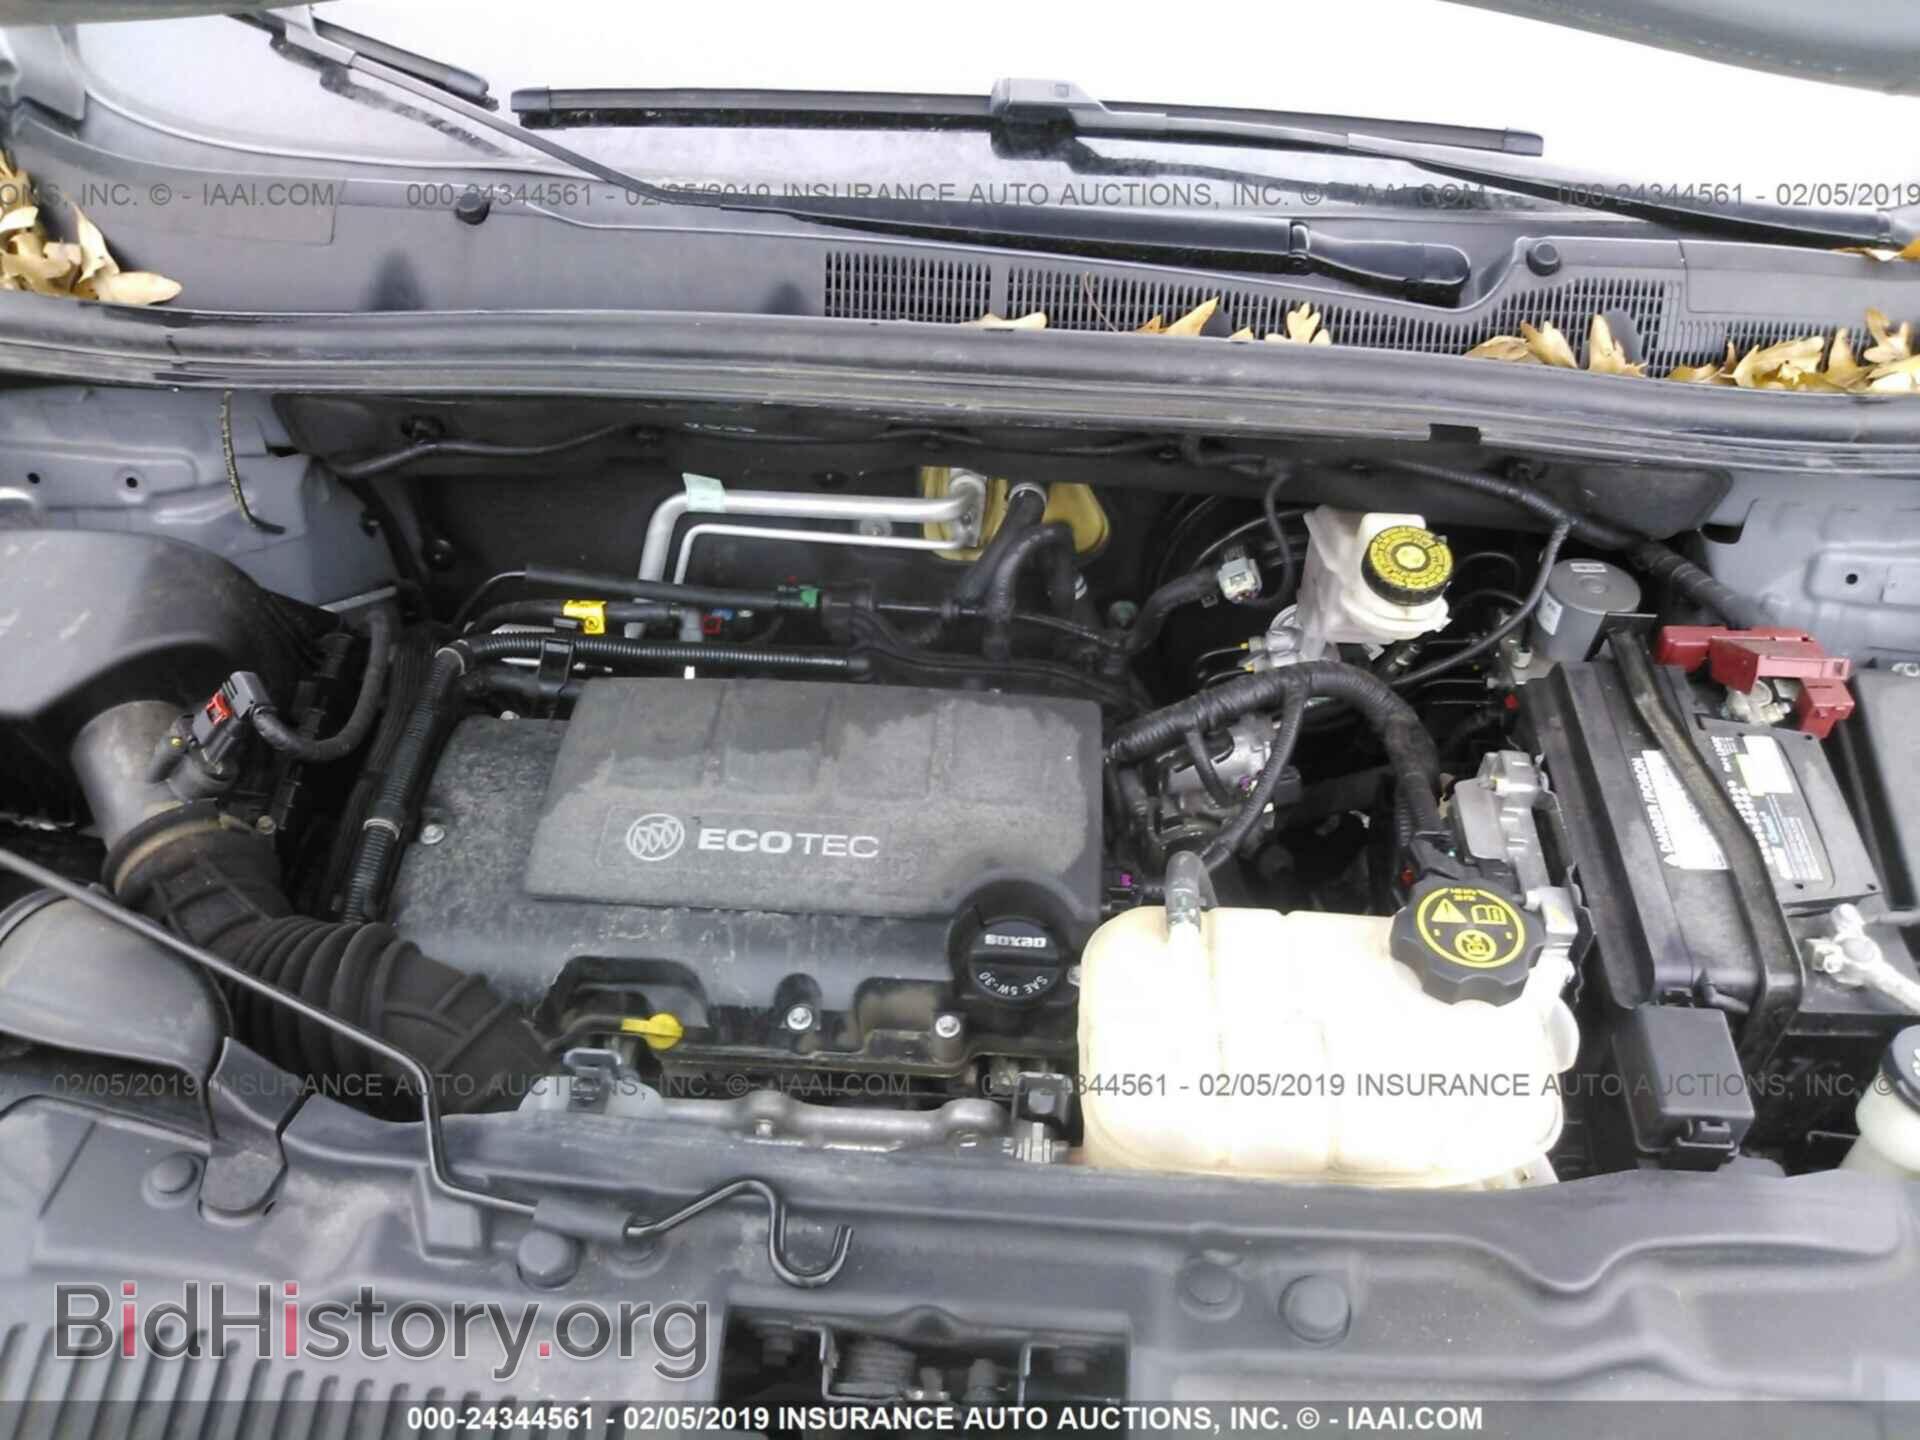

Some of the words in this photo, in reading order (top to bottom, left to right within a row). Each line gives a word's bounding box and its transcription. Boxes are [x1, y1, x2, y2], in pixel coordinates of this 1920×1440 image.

[698, 827, 880, 858] ECOTEC
[978, 971, 1018, 996] 5W-30
[1022, 975, 1048, 995] SAE
